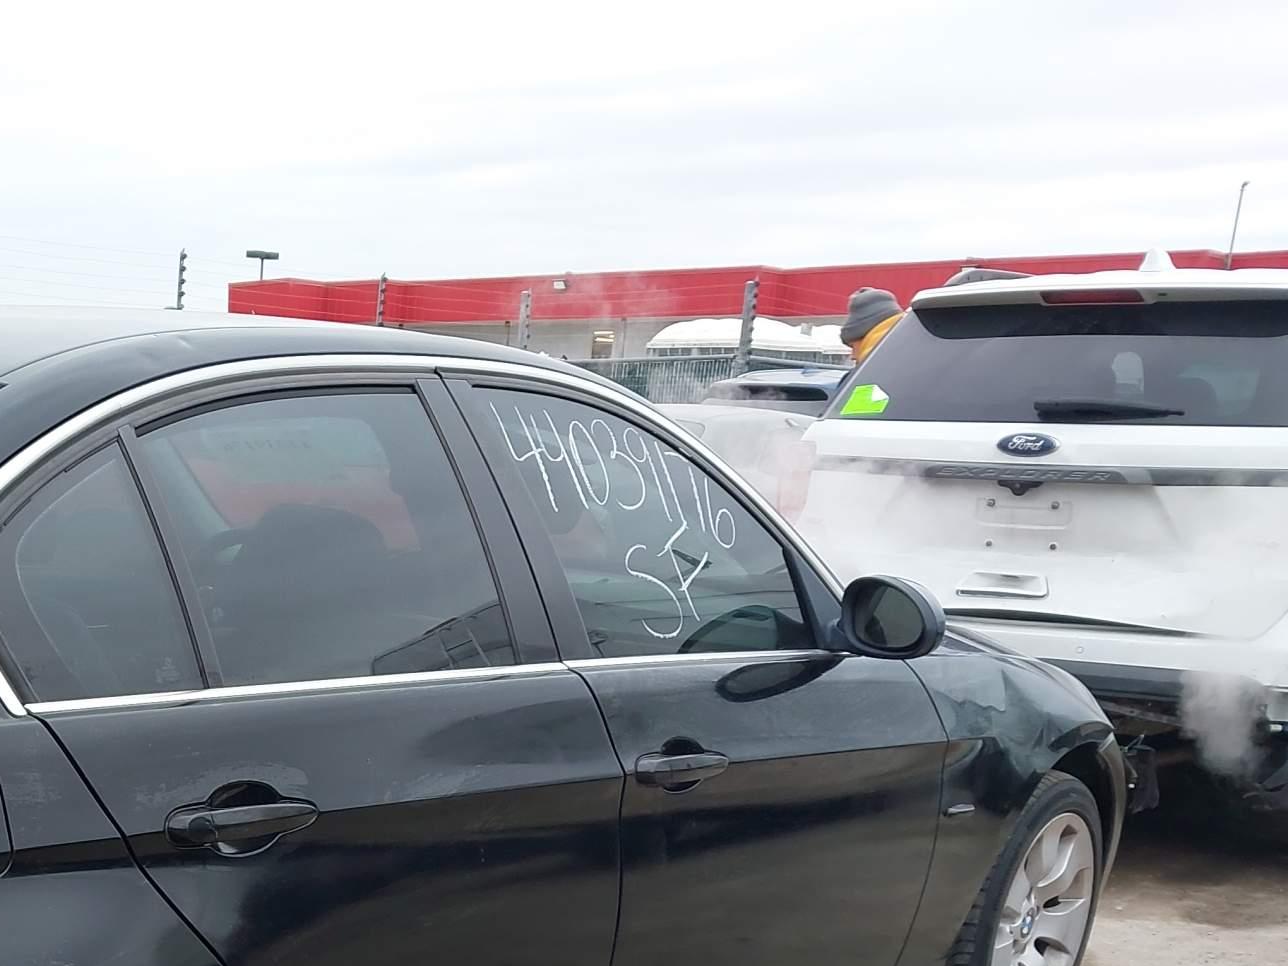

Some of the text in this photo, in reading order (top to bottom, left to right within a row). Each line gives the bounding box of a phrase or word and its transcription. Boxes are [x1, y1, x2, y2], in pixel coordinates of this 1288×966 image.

[1008, 435, 1044, 451] Ford
[489, 402, 736, 549] 44039176
[935, 465, 1113, 482] EXPLORER
